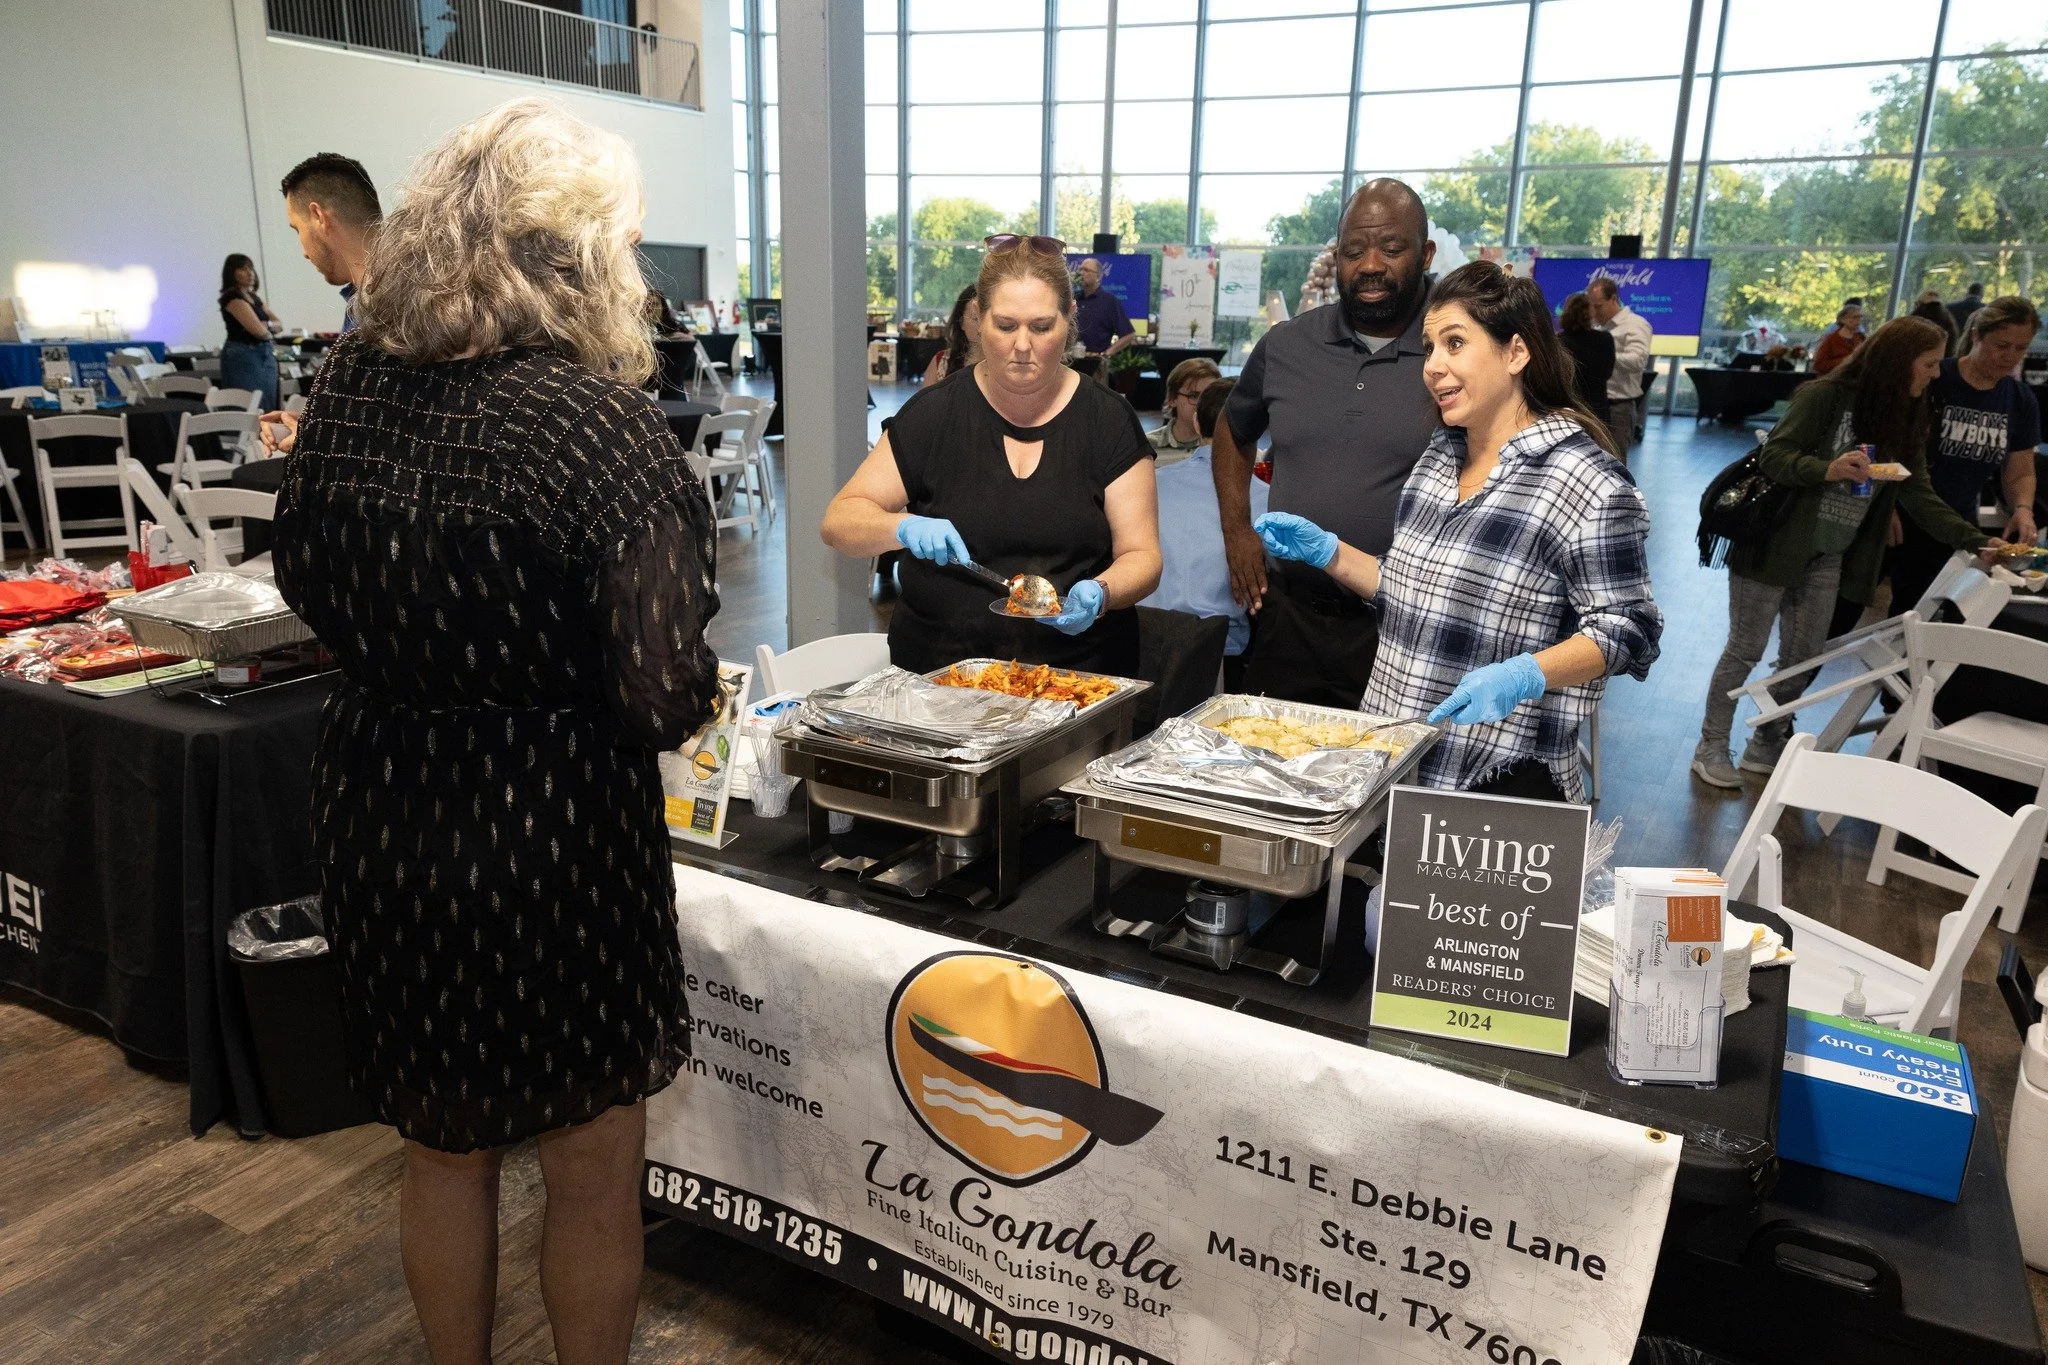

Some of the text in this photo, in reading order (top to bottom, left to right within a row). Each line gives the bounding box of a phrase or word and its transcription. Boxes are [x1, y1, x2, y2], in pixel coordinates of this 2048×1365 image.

[1416, 863, 1518, 887] MAGAZINE
[1417, 813, 1555, 894] living
[0, 871, 42, 932] EI
[1427, 893, 1536, 941] best of
[1426, 955, 1525, 982] & MANSFIELD
[1433, 936, 1520, 961] ARLINGTON
[686, 973, 764, 1015] e cater
[1392, 973, 1556, 1010] READERS' CHOICE
[687, 1013, 792, 1067] ervations
[1446, 1009, 1493, 1031] 2024
[1883, 1029, 1921, 1044] Plastic
[1818, 1034, 1960, 1077] Heavy Duty
[1922, 1040, 1955, 1052] Clear
[714, 1063, 824, 1119] welcome
[1858, 1070, 1896, 1084] count
[1896, 1081, 1963, 1107] 360
[1897, 1063, 1963, 1089] Extra
[647, 1165, 843, 1266] 682-518-1235
[861, 1139, 1183, 1291] La Gondola
[1215, 1135, 1607, 1282] 1211 E. Debbie Lane
[867, 1188, 1172, 1319] Fine Italian Cuisine & Bar
[1319, 1220, 1472, 1291] Ste. 129
[914, 1238, 1115, 1330] Established since 1979
[1206, 1230, 1563, 1365] Mansfield, TX 760
[902, 1268, 1150, 1365] www.lagond
